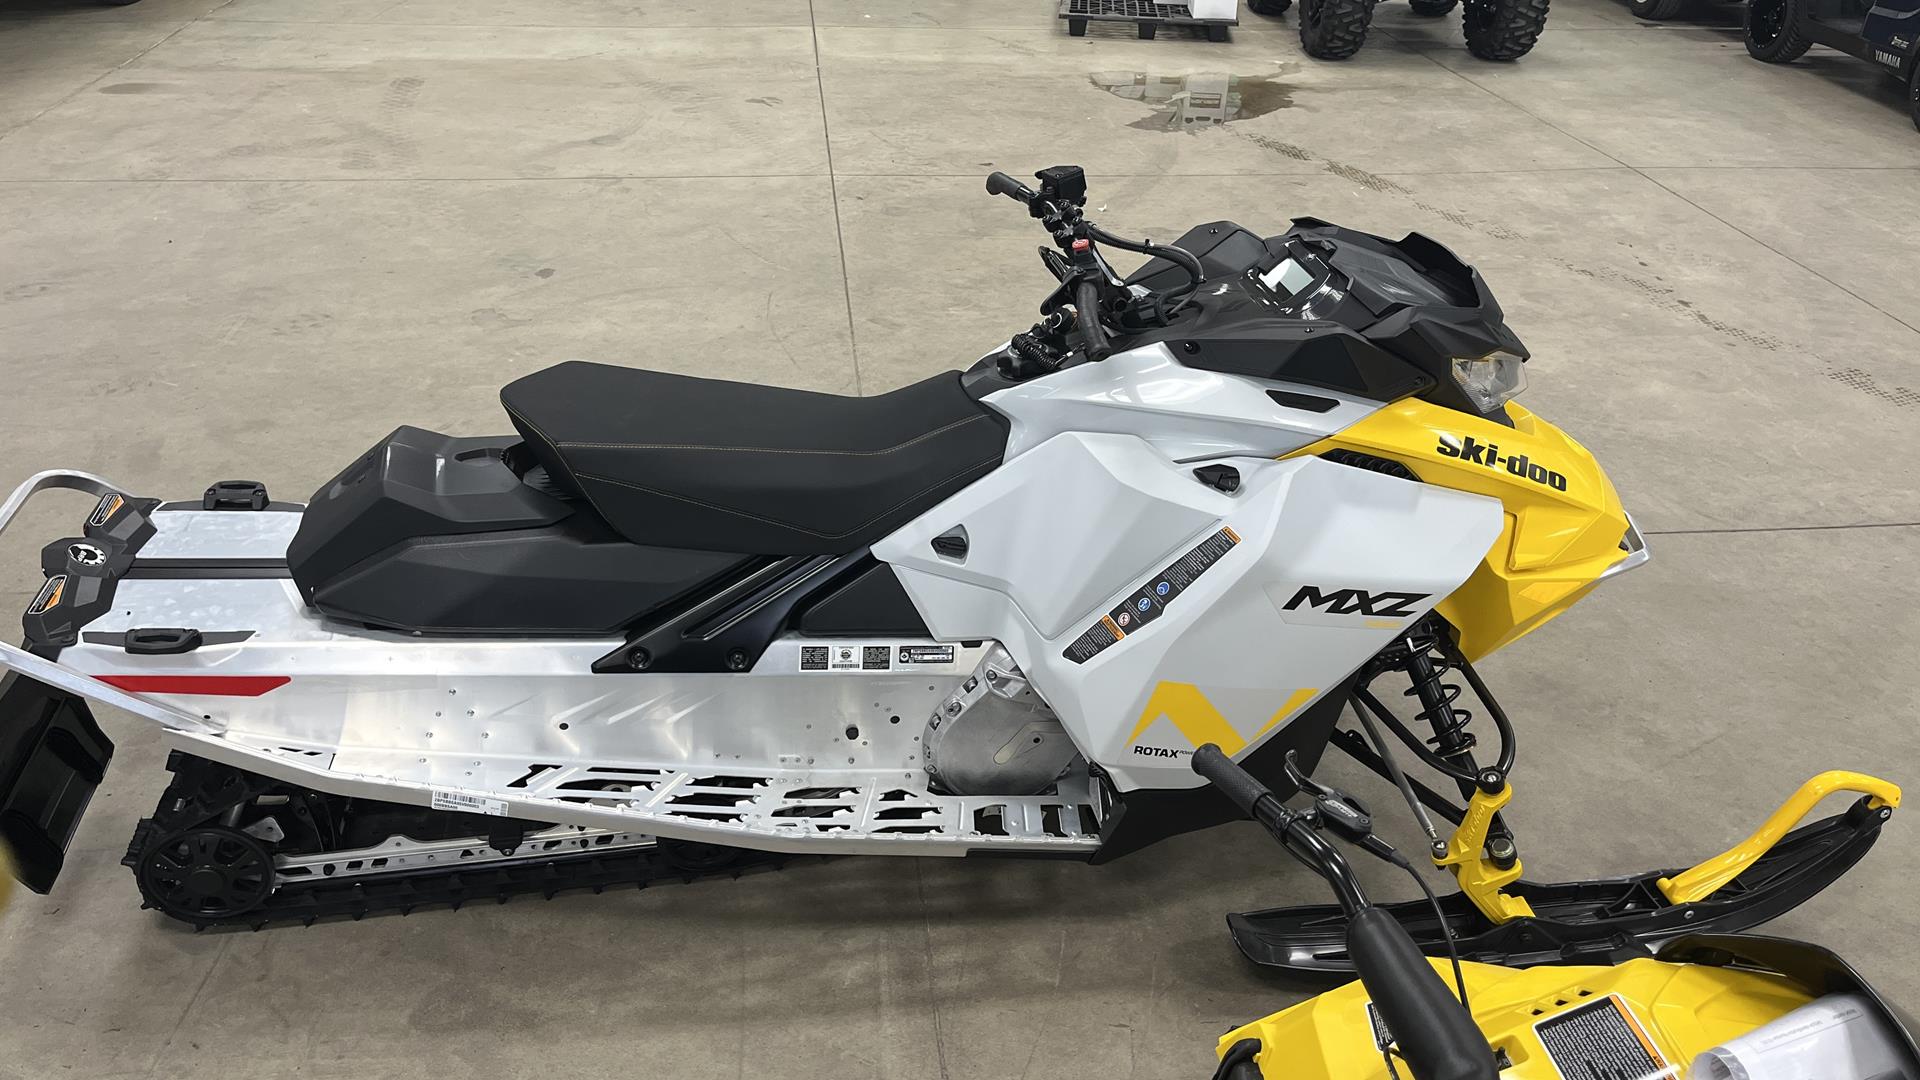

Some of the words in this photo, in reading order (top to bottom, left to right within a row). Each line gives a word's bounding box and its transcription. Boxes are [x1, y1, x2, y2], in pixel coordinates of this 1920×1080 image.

[1875, 49, 1901, 68] YAMAHA
[1281, 585, 1433, 617] MXZ
[1133, 745, 1180, 758] ROTAX
